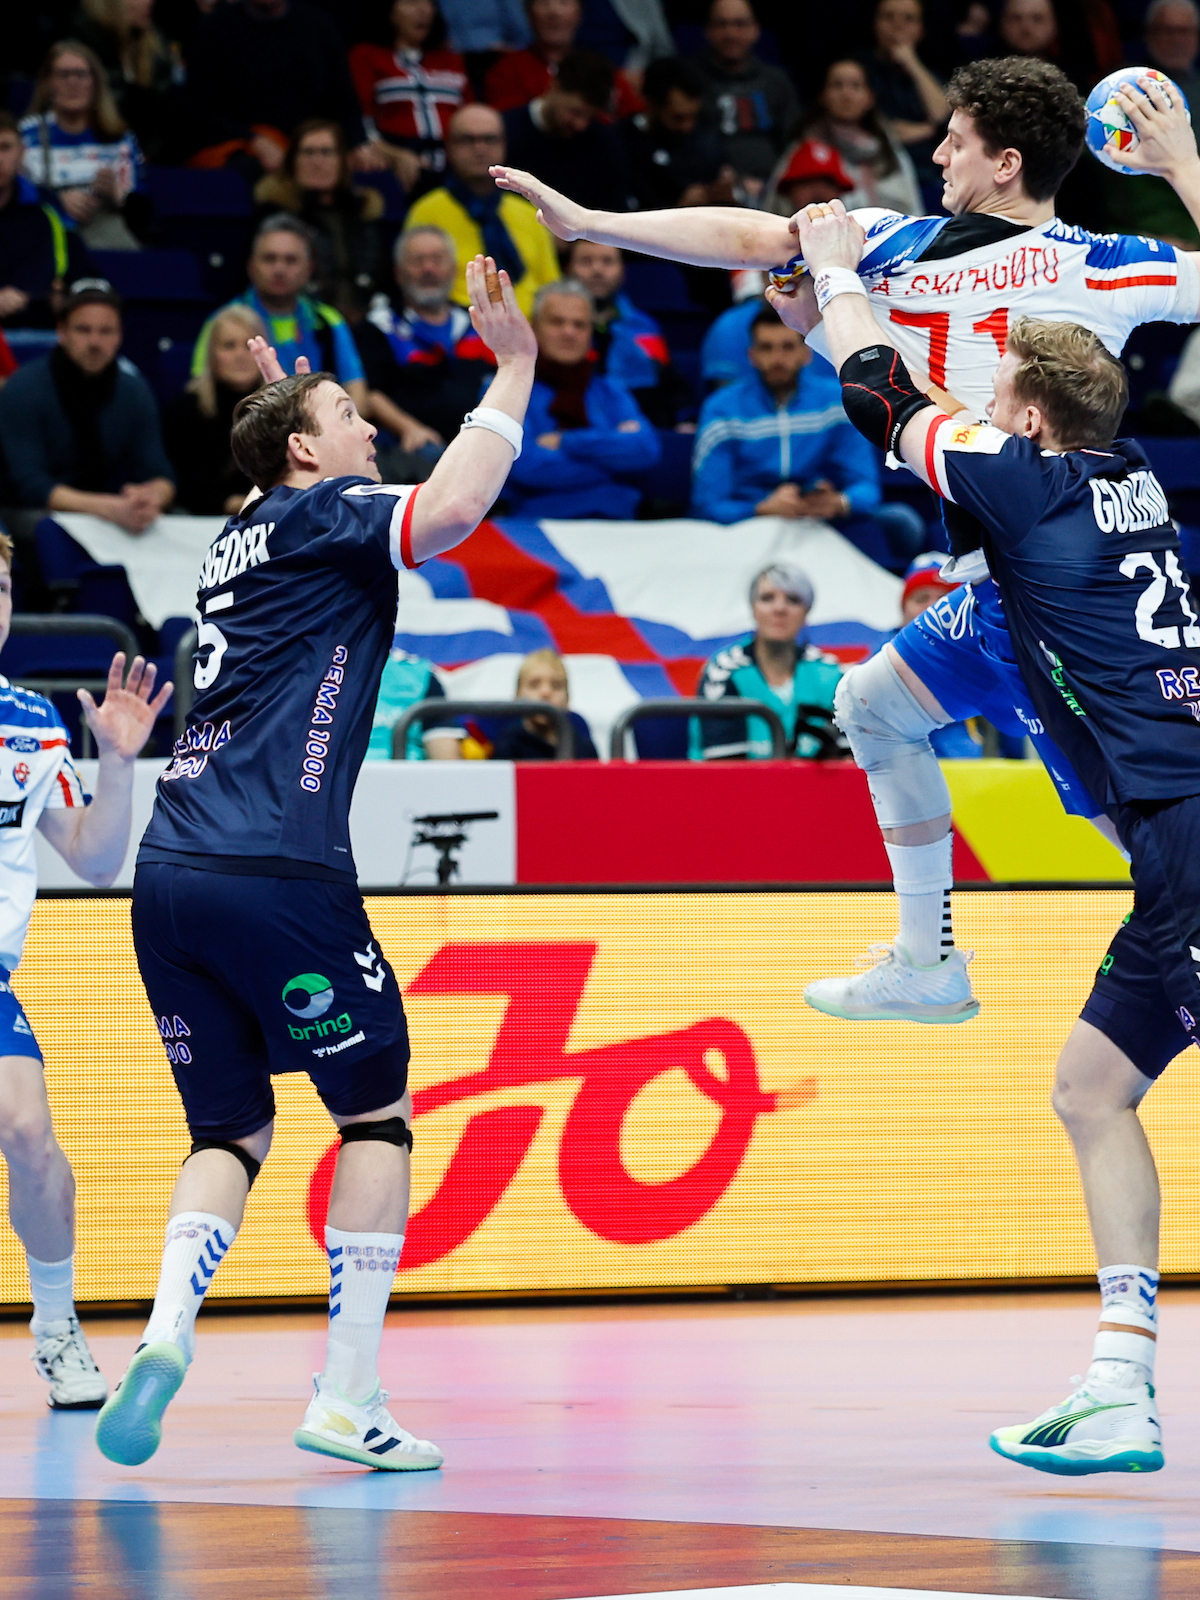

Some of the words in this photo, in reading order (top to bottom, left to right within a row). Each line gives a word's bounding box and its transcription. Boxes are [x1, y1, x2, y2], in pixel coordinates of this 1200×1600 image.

[193, 591, 235, 690] 5
[311, 645, 348, 724] REMA
[300, 729, 331, 793] 1000
[156, 1015, 191, 1038] MA
[287, 1012, 352, 1040] bring
[166, 1042, 192, 1065] 00
[326, 1030, 366, 1055] hummel
